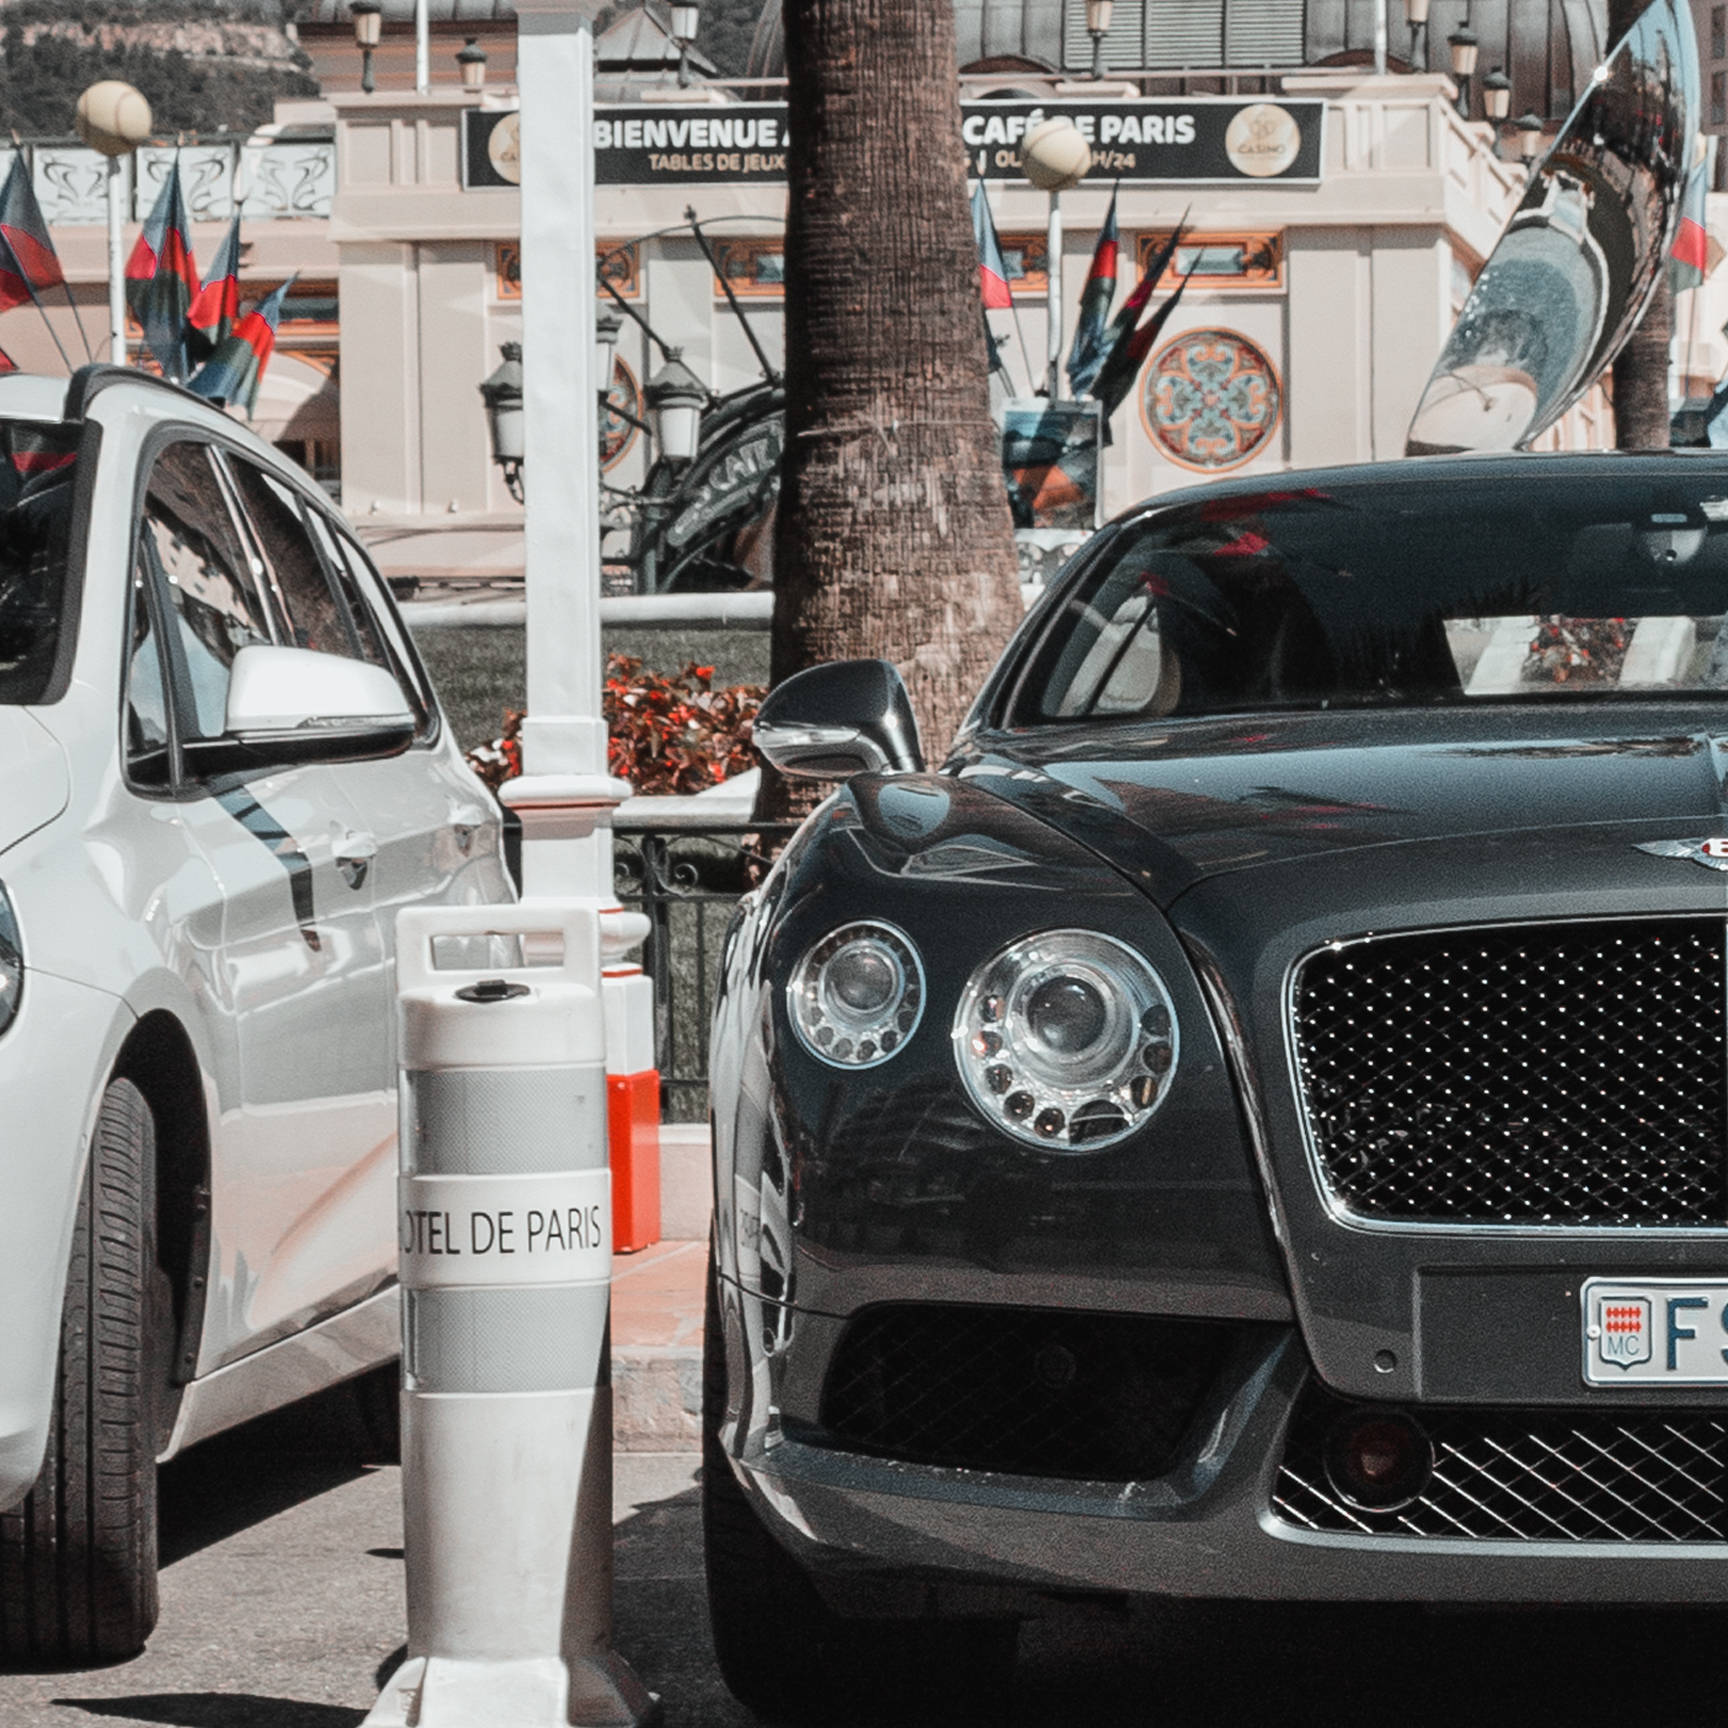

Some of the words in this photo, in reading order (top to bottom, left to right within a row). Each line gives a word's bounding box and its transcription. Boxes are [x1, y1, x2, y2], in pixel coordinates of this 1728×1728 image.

[593, 119, 778, 149] BIENVENUE
[1101, 115, 1196, 144] PARIS
[648, 153, 714, 171] TABLES
[717, 153, 741, 171] DE
[742, 153, 787, 173] JEUX
[471, 1211, 515, 1255] DE
[527, 1205, 601, 1254] PARIS
[1607, 1335, 1641, 1356] MC
